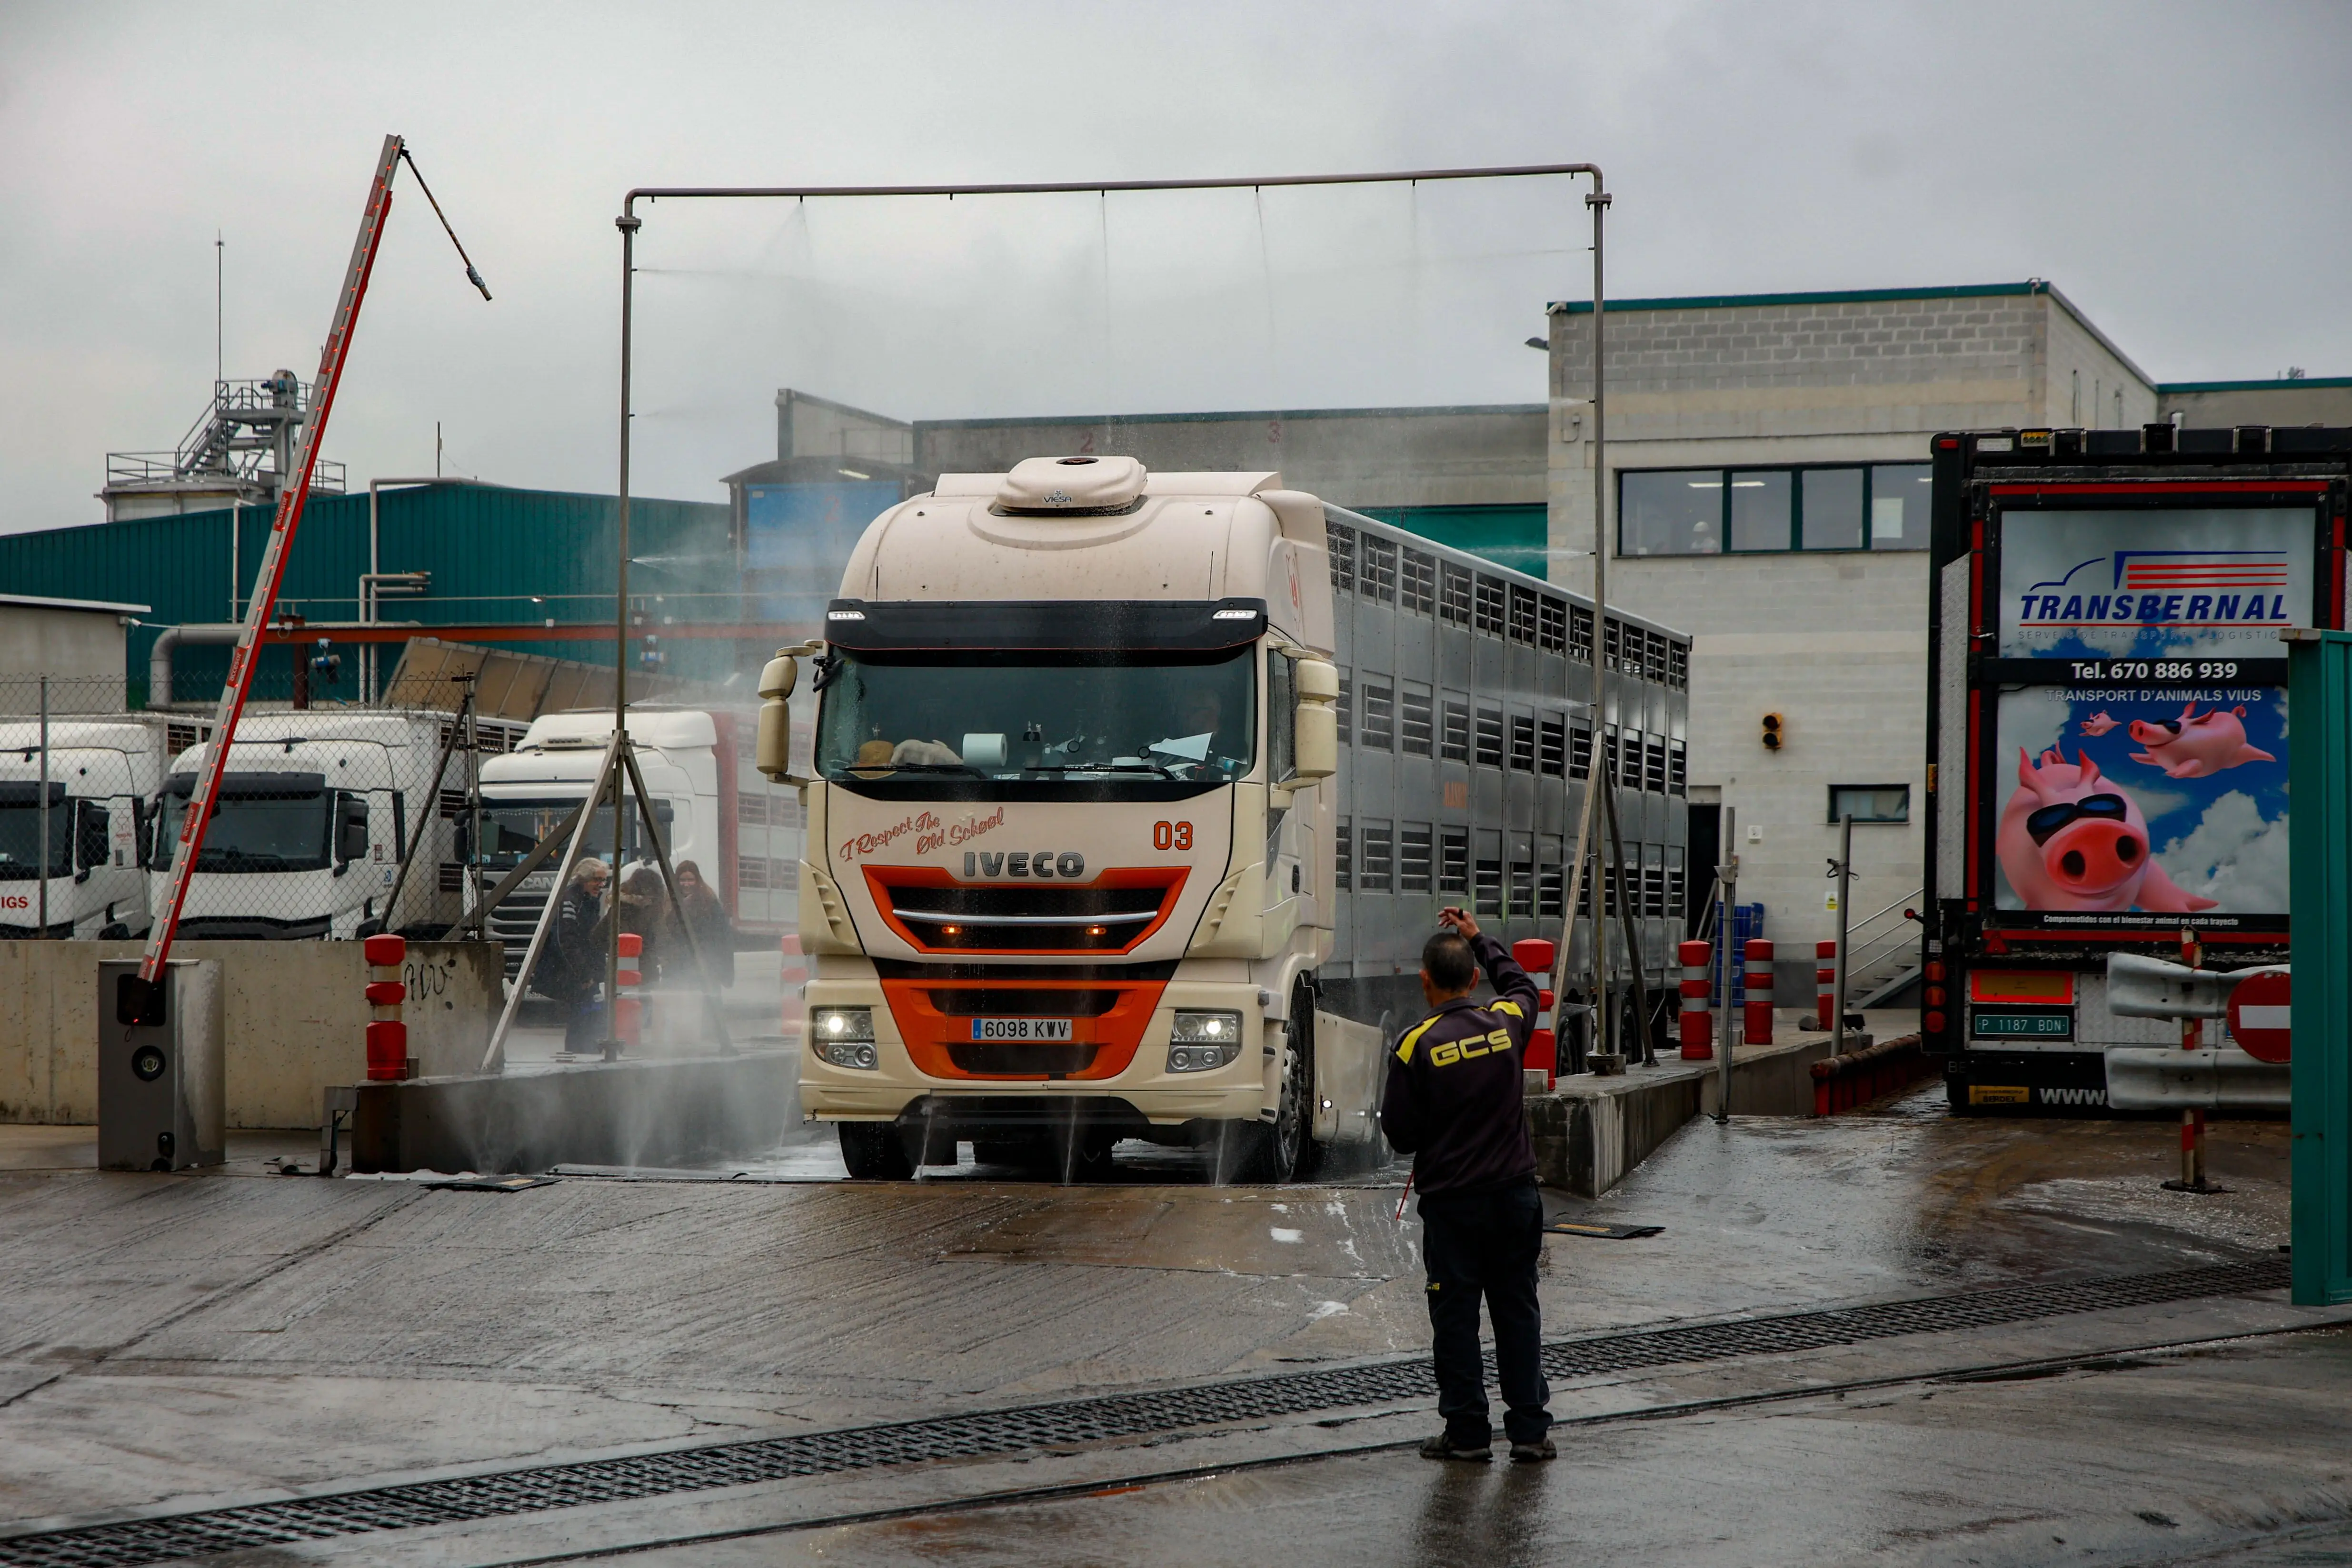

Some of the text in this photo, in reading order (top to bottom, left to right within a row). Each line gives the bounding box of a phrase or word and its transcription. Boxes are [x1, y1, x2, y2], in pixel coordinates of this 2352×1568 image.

[1080, 431, 1094, 453] 2
[1267, 421, 1281, 444] 3
[824, 495, 840, 522] 2
[2021, 595, 2288, 620] TRANSBERNAL
[2082, 631, 2096, 639] DE
[2209, 631, 2277, 639] LOGISTIC
[2071, 662, 2238, 679] Tel. 670 886 939
[2045, 690, 2136, 701] TRANSPORT
[2226, 689, 2262, 701] VIUS
[839, 811, 941, 863] I Respect The
[1154, 821, 1193, 851] 03
[964, 852, 1085, 877] IVECO
[2043, 914, 2097, 923] Comprometidos
[2122, 916, 2154, 924] bienestar
[2155, 916, 2179, 924] animal
[2210, 918, 2239, 926] trayecto
[985, 1022, 1067, 1038] 6098 KWV
[1982, 1019, 2062, 1031] P 1187 BDN
[1430, 1028, 1512, 1067] GCS
